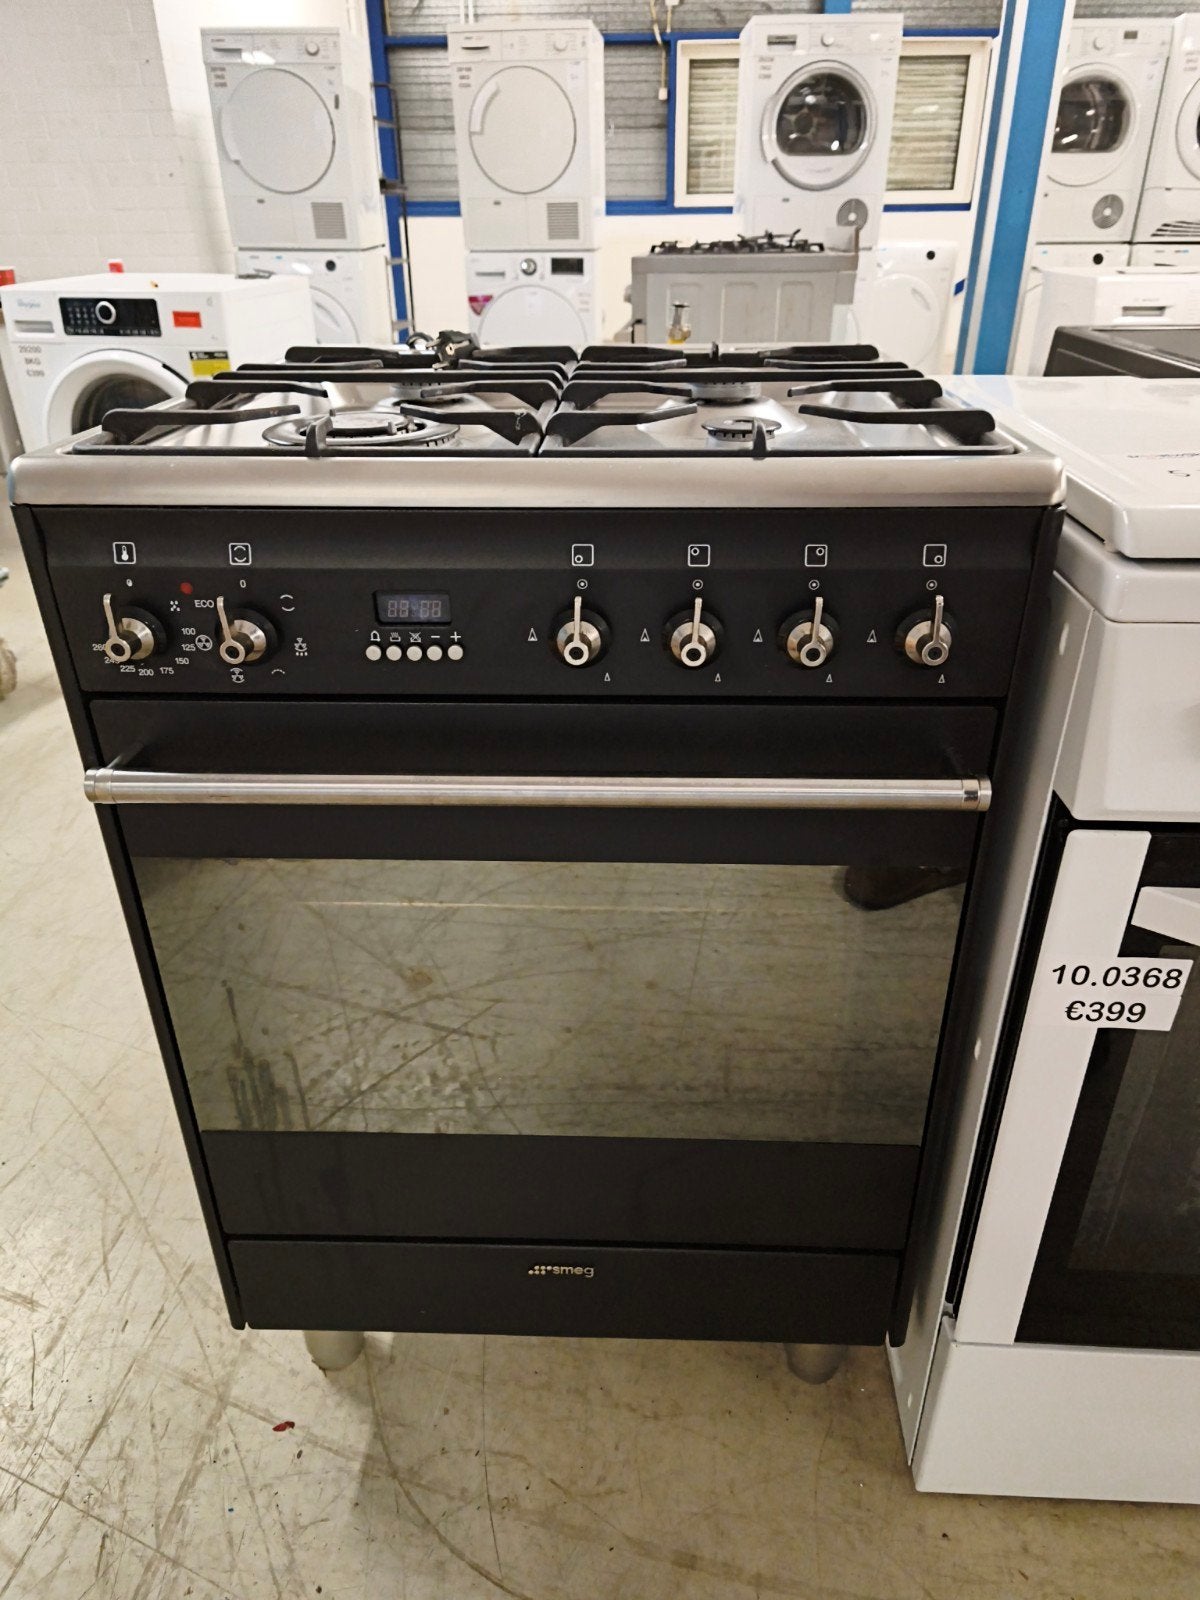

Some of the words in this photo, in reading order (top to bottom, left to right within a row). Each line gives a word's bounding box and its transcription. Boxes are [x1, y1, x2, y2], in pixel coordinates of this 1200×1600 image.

[194, 599, 215, 608] ECO
[181, 627, 196, 636] 100
[181, 643, 196, 652] 125
[175, 657, 190, 665] 150
[120, 664, 136, 673] 225
[138, 668, 154, 677] 200
[159, 666, 175, 675] 175
[1052, 964, 1183, 989] 10.0368
[1064, 1000, 1147, 1023] €399
[552, 1265, 595, 1278] smeg
